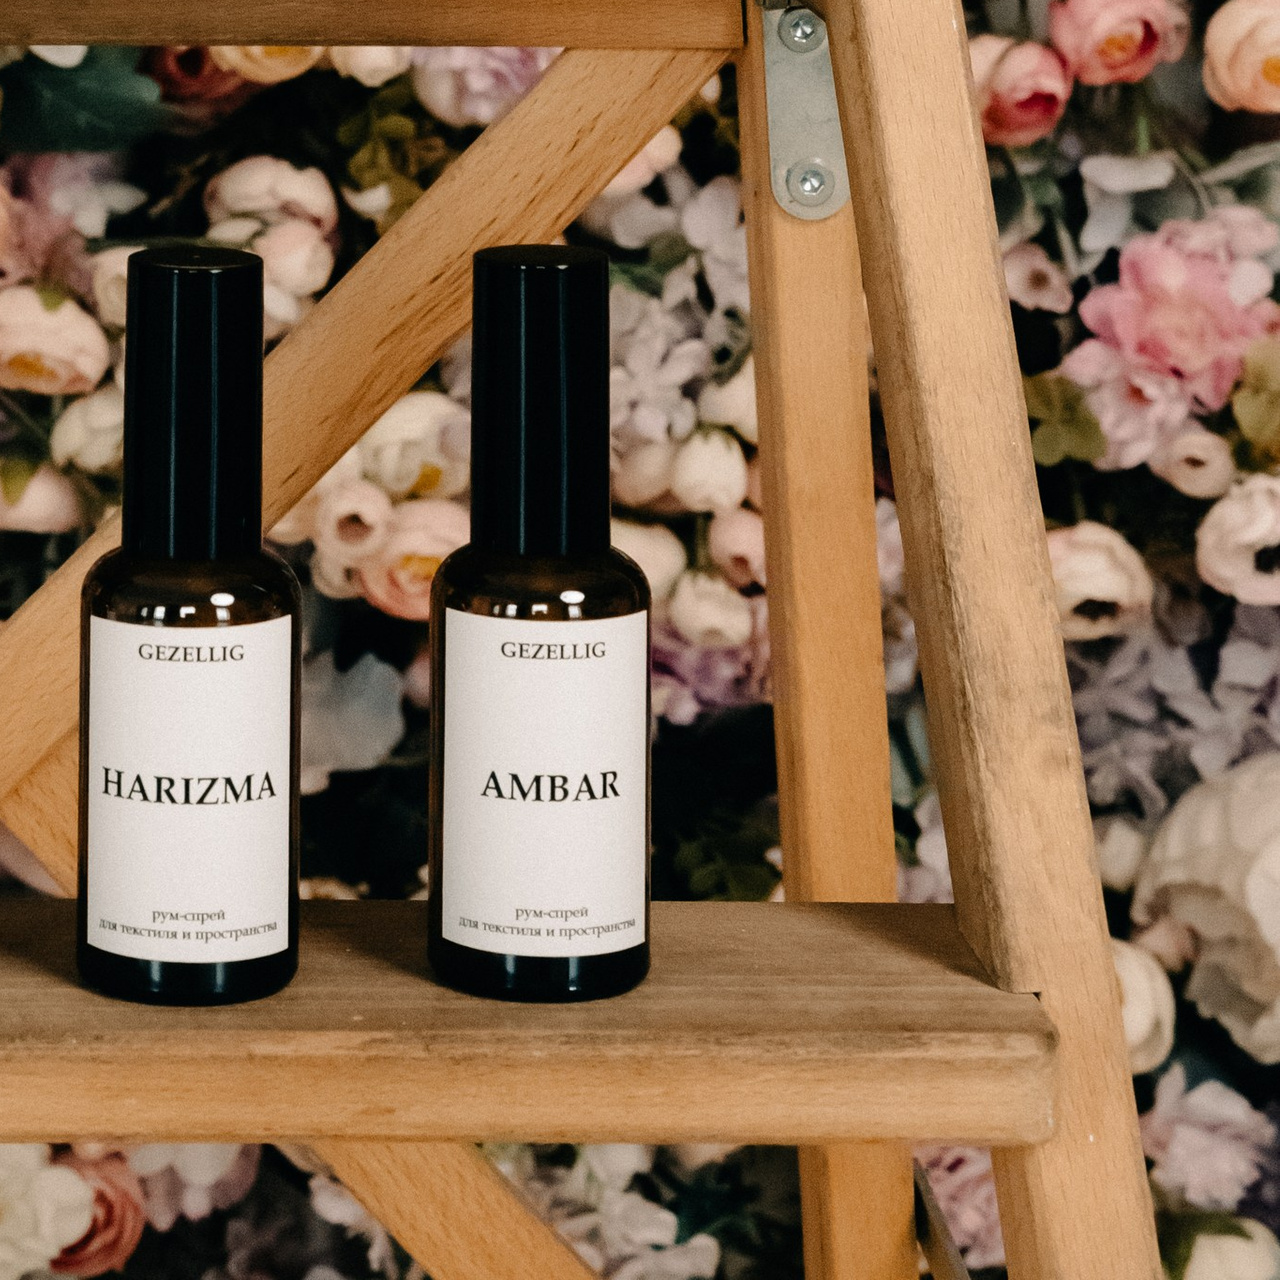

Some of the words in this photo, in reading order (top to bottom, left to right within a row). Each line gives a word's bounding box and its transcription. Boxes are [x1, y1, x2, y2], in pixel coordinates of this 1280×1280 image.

[138, 643, 244, 663] GEZELLIG
[500, 641, 606, 660] GEZELLIG
[101, 765, 277, 805] HARIZMA
[480, 770, 621, 803] AMBAR
[152, 908, 226, 924] рум-спрей
[515, 906, 588, 922] рум-спрей
[99, 919, 117, 932] для
[120, 924, 178, 940] текстиля
[182, 929, 191, 939] и
[195, 920, 278, 943] пространства
[459, 917, 478, 929] для
[482, 922, 541, 937] текстиля
[546, 928, 554, 937] и
[559, 917, 636, 940] пространства
